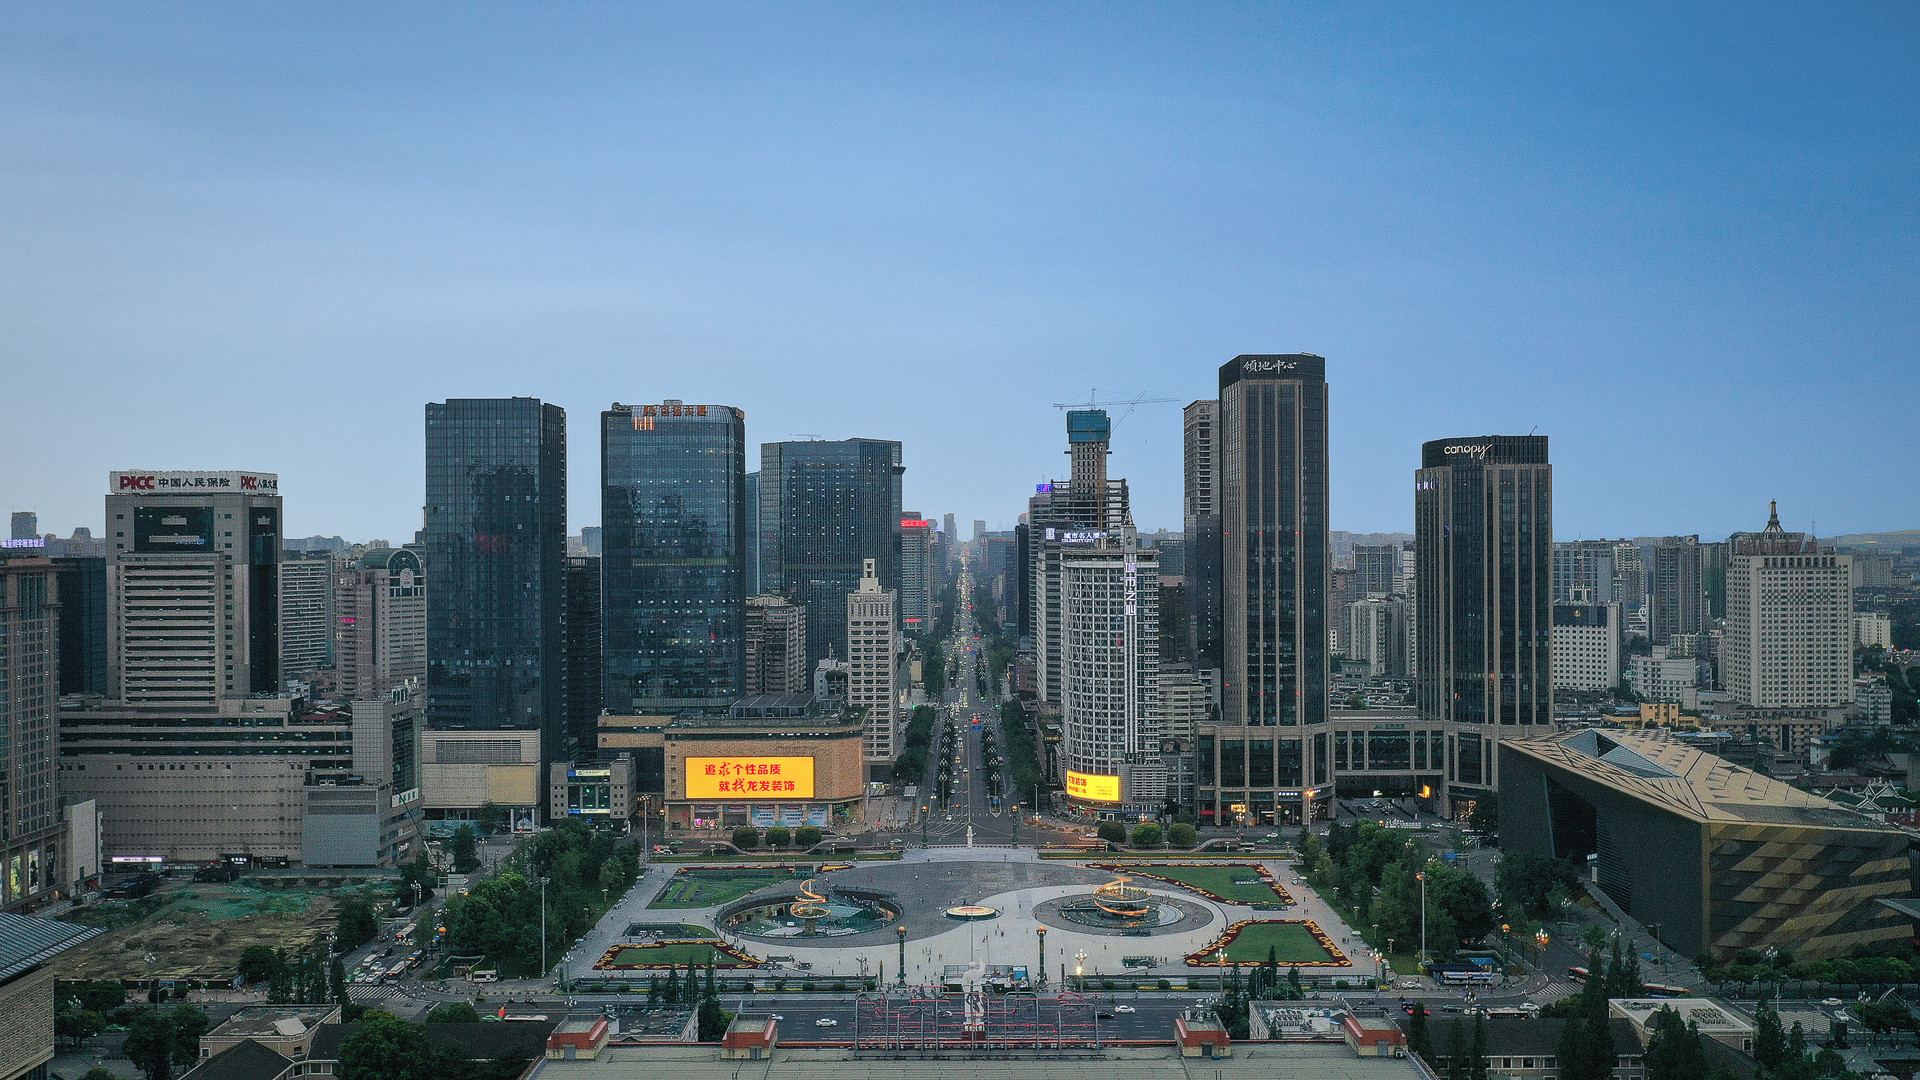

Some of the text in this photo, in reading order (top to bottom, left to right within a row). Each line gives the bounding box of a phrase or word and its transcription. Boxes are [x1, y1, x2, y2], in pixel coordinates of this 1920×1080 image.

[1444, 443, 1493, 460] canopy
[120, 476, 231, 490] PICC 中国人民保险
[240, 475, 257, 490] PICC
[704, 762, 781, 777] 追求个性品质
[718, 778, 795, 793] 就找龙发装饰
